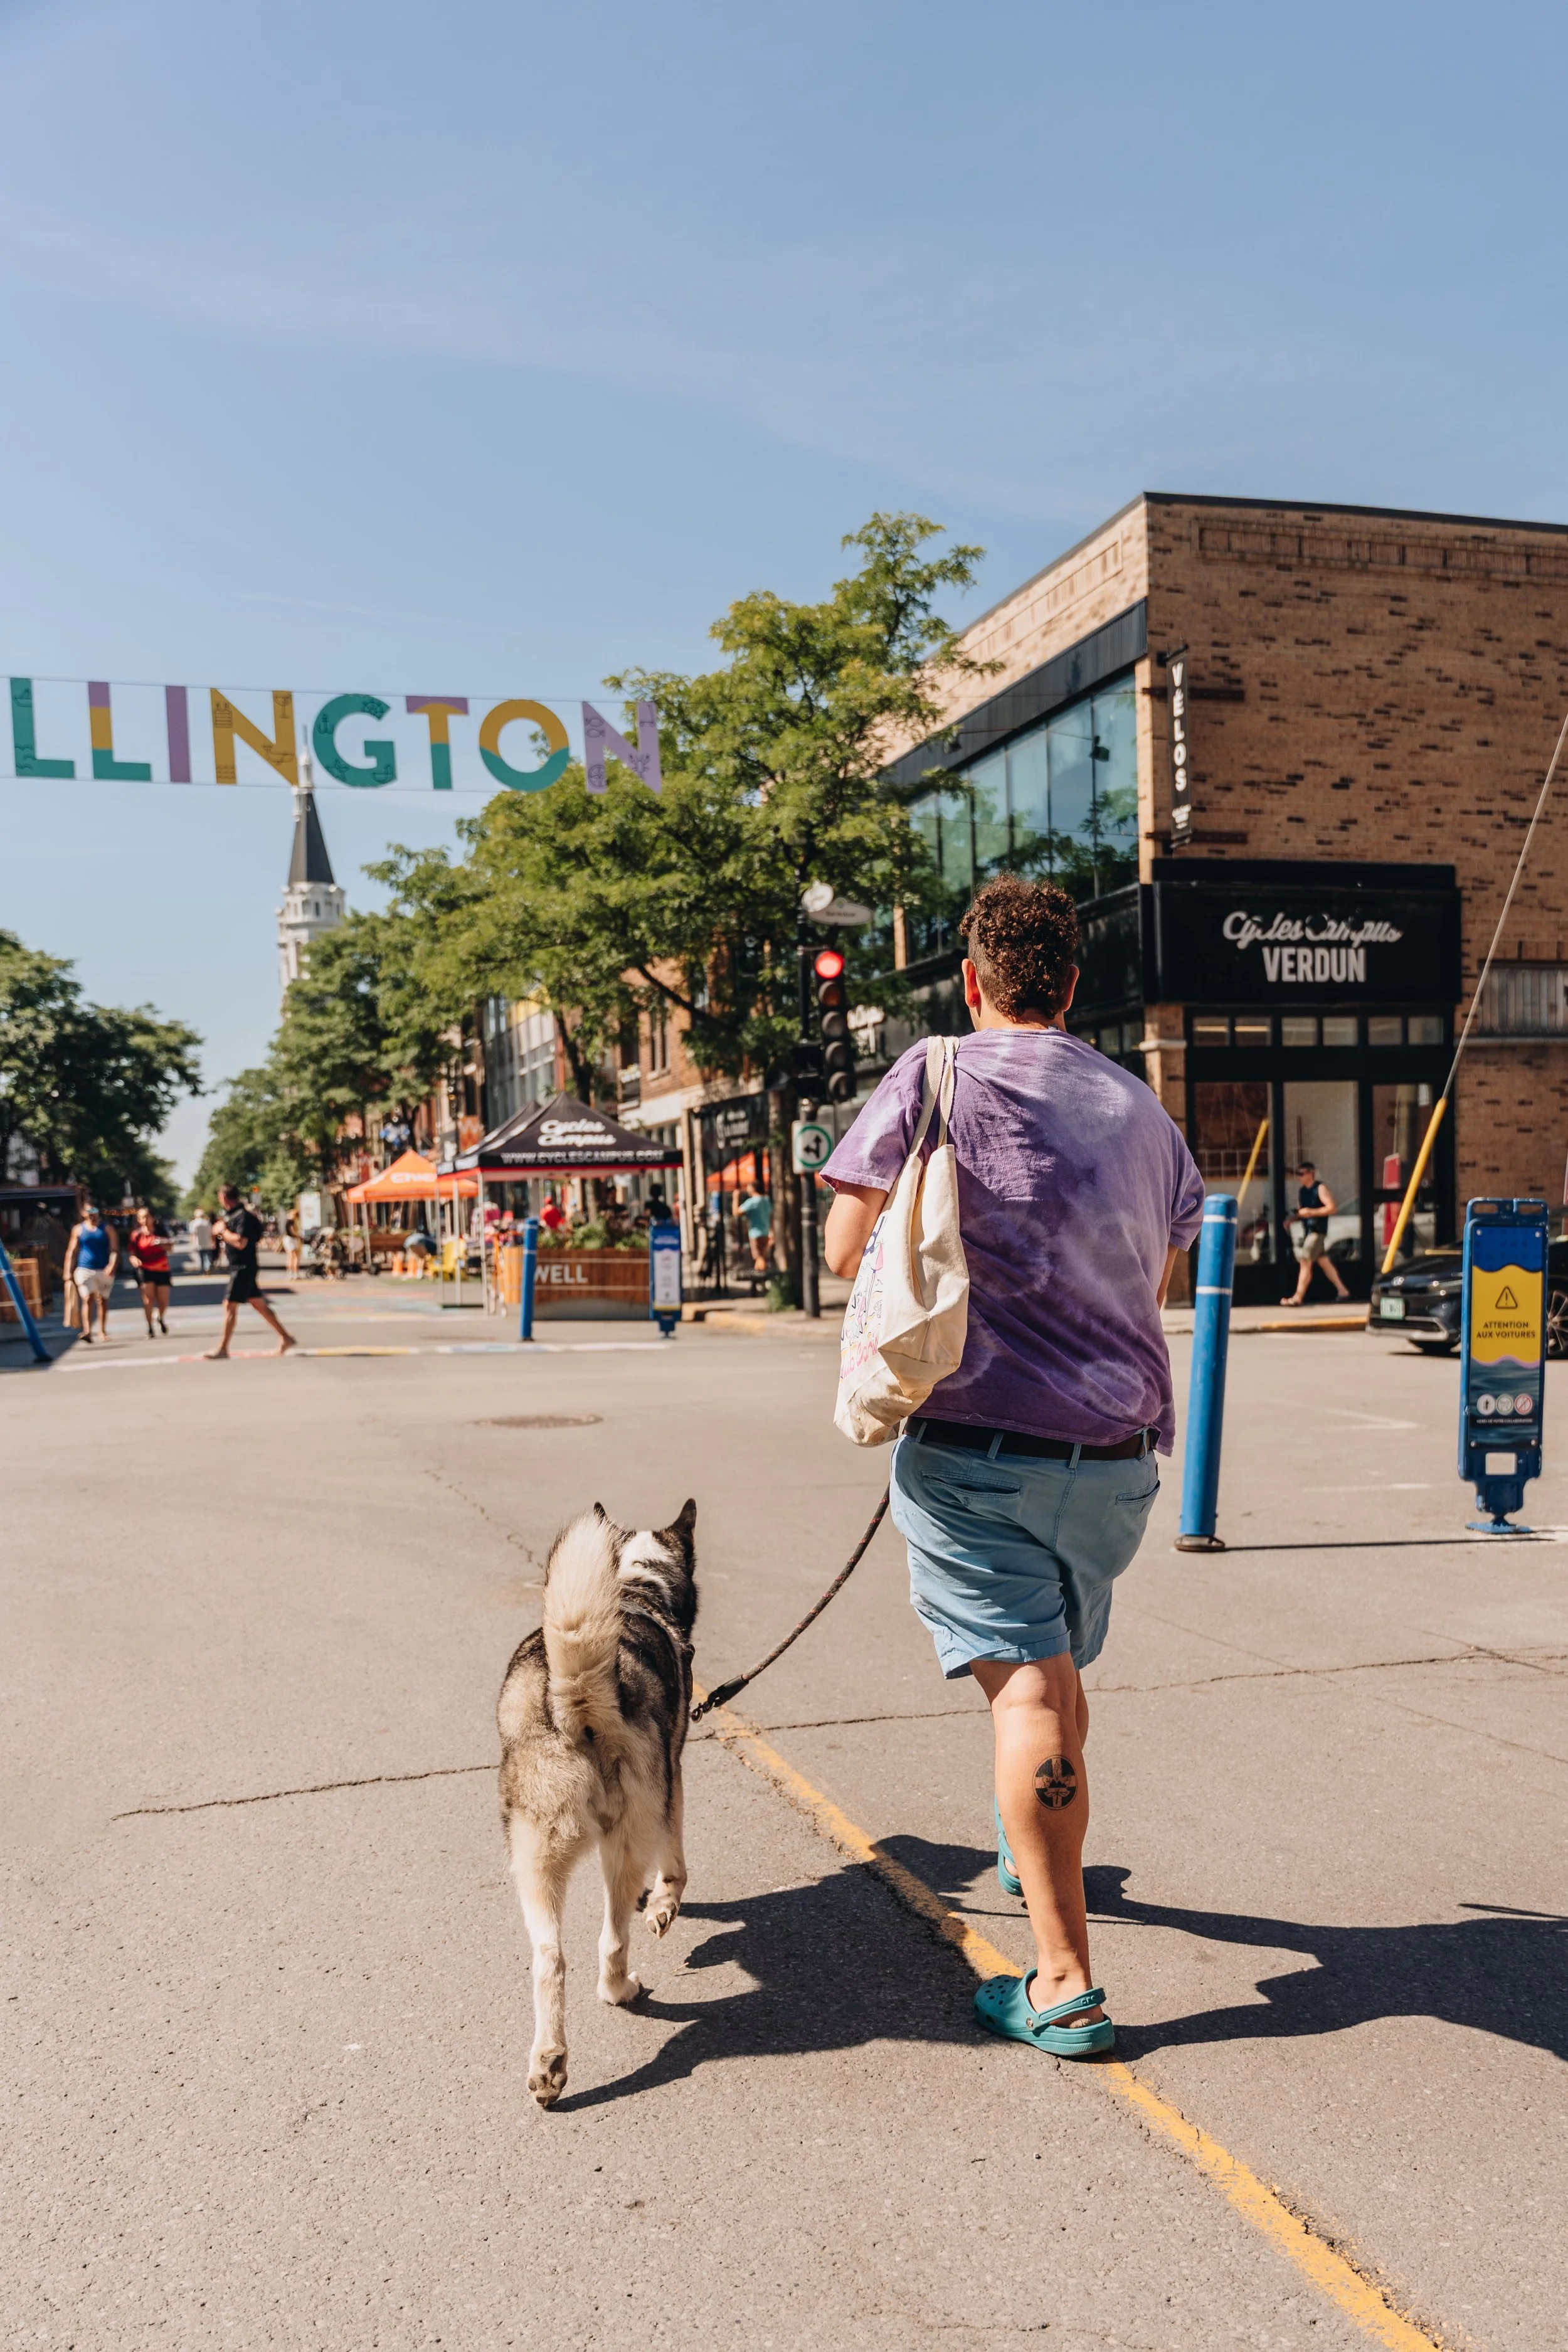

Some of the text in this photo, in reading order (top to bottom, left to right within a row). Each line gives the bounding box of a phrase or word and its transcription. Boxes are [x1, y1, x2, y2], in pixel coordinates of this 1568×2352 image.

[10, 677, 662, 794] LLINGTON
[1262, 946, 1366, 982] VERDUN
[538, 1133, 617, 1147] Campus
[540, 1118, 605, 1136] Cycles
